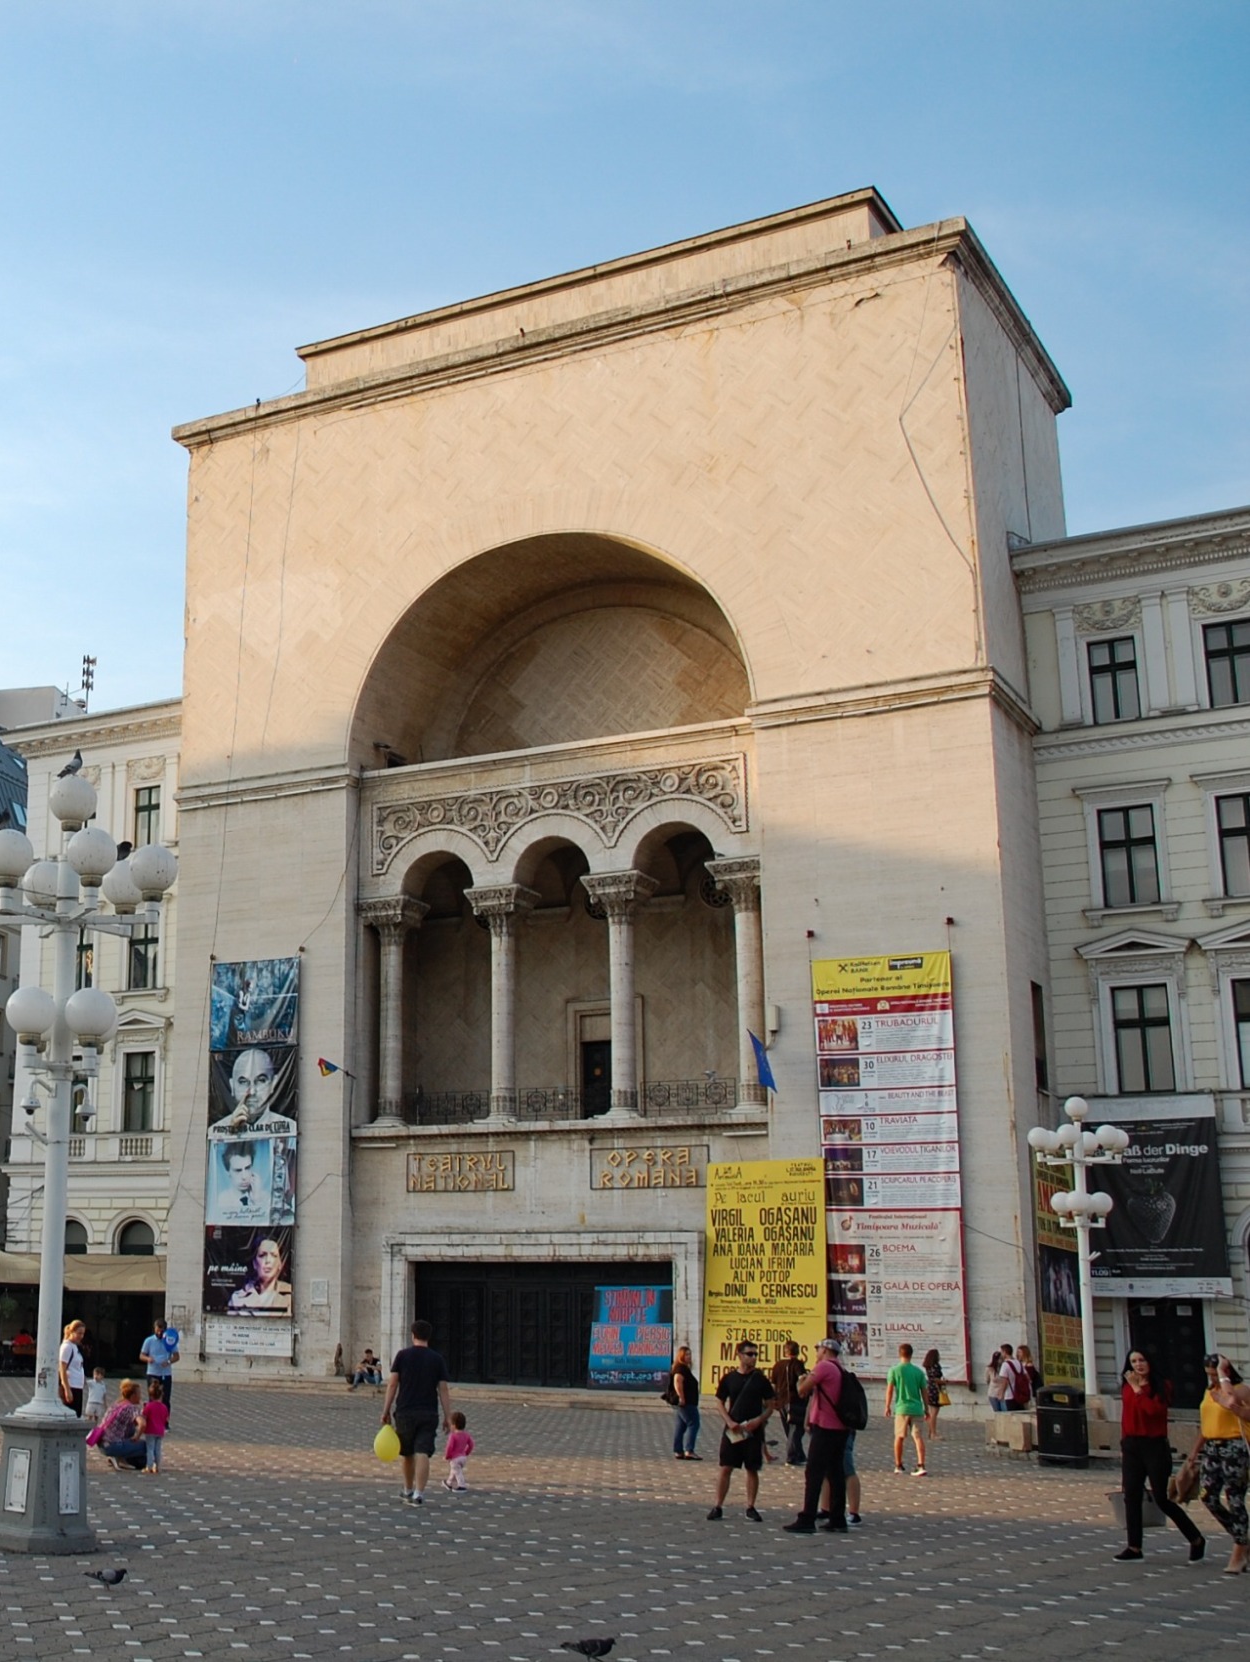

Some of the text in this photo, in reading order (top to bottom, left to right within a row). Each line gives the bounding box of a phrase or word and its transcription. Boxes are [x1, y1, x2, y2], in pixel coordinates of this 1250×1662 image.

[861, 1021, 872, 1030] 23
[875, 1018, 938, 1028] TRUBADURUL
[236, 1027, 294, 1041] RAMBUKU
[911, 1052, 953, 1062] DRAGOSTEI
[863, 1060, 875, 1070] 30
[887, 1091, 909, 1099] BEAUTY
[879, 1116, 918, 1124] TRAVIATA
[865, 1122, 875, 1130] 10
[867, 1150, 877, 1159] 17
[1143, 1145, 1164, 1155] der
[1165, 1143, 1209, 1156] Dinge
[608, 1147, 691, 1167] OPERA
[410, 1171, 510, 1192] NATIONAL
[600, 1167, 698, 1188] ROMANA
[868, 1181, 878, 1190] 21
[736, 1191, 765, 1203] lacul
[781, 1189, 815, 1202] auriu
[711, 1208, 745, 1226] VIRGIL
[714, 1227, 754, 1242] VALERIA
[713, 1242, 814, 1256] ANA IOANA MACARIA
[869, 1248, 881, 1257] 26
[882, 1244, 917, 1253] BOEMA
[730, 1257, 795, 1269] LUCIAN IFRIM
[207, 1264, 219, 1275] pe
[733, 1270, 790, 1282] ALIN POTOP
[725, 1283, 747, 1297] DINU
[761, 1283, 818, 1298] CERNESCU
[870, 1285, 882, 1294] 28
[883, 1281, 961, 1291] GALĂ DE OPERĂ
[871, 1328, 882, 1336] 31
[885, 1323, 925, 1332] LILIACUL
[726, 1328, 792, 1342] STAGE DOGS
[720, 1342, 771, 1362] MAEL
